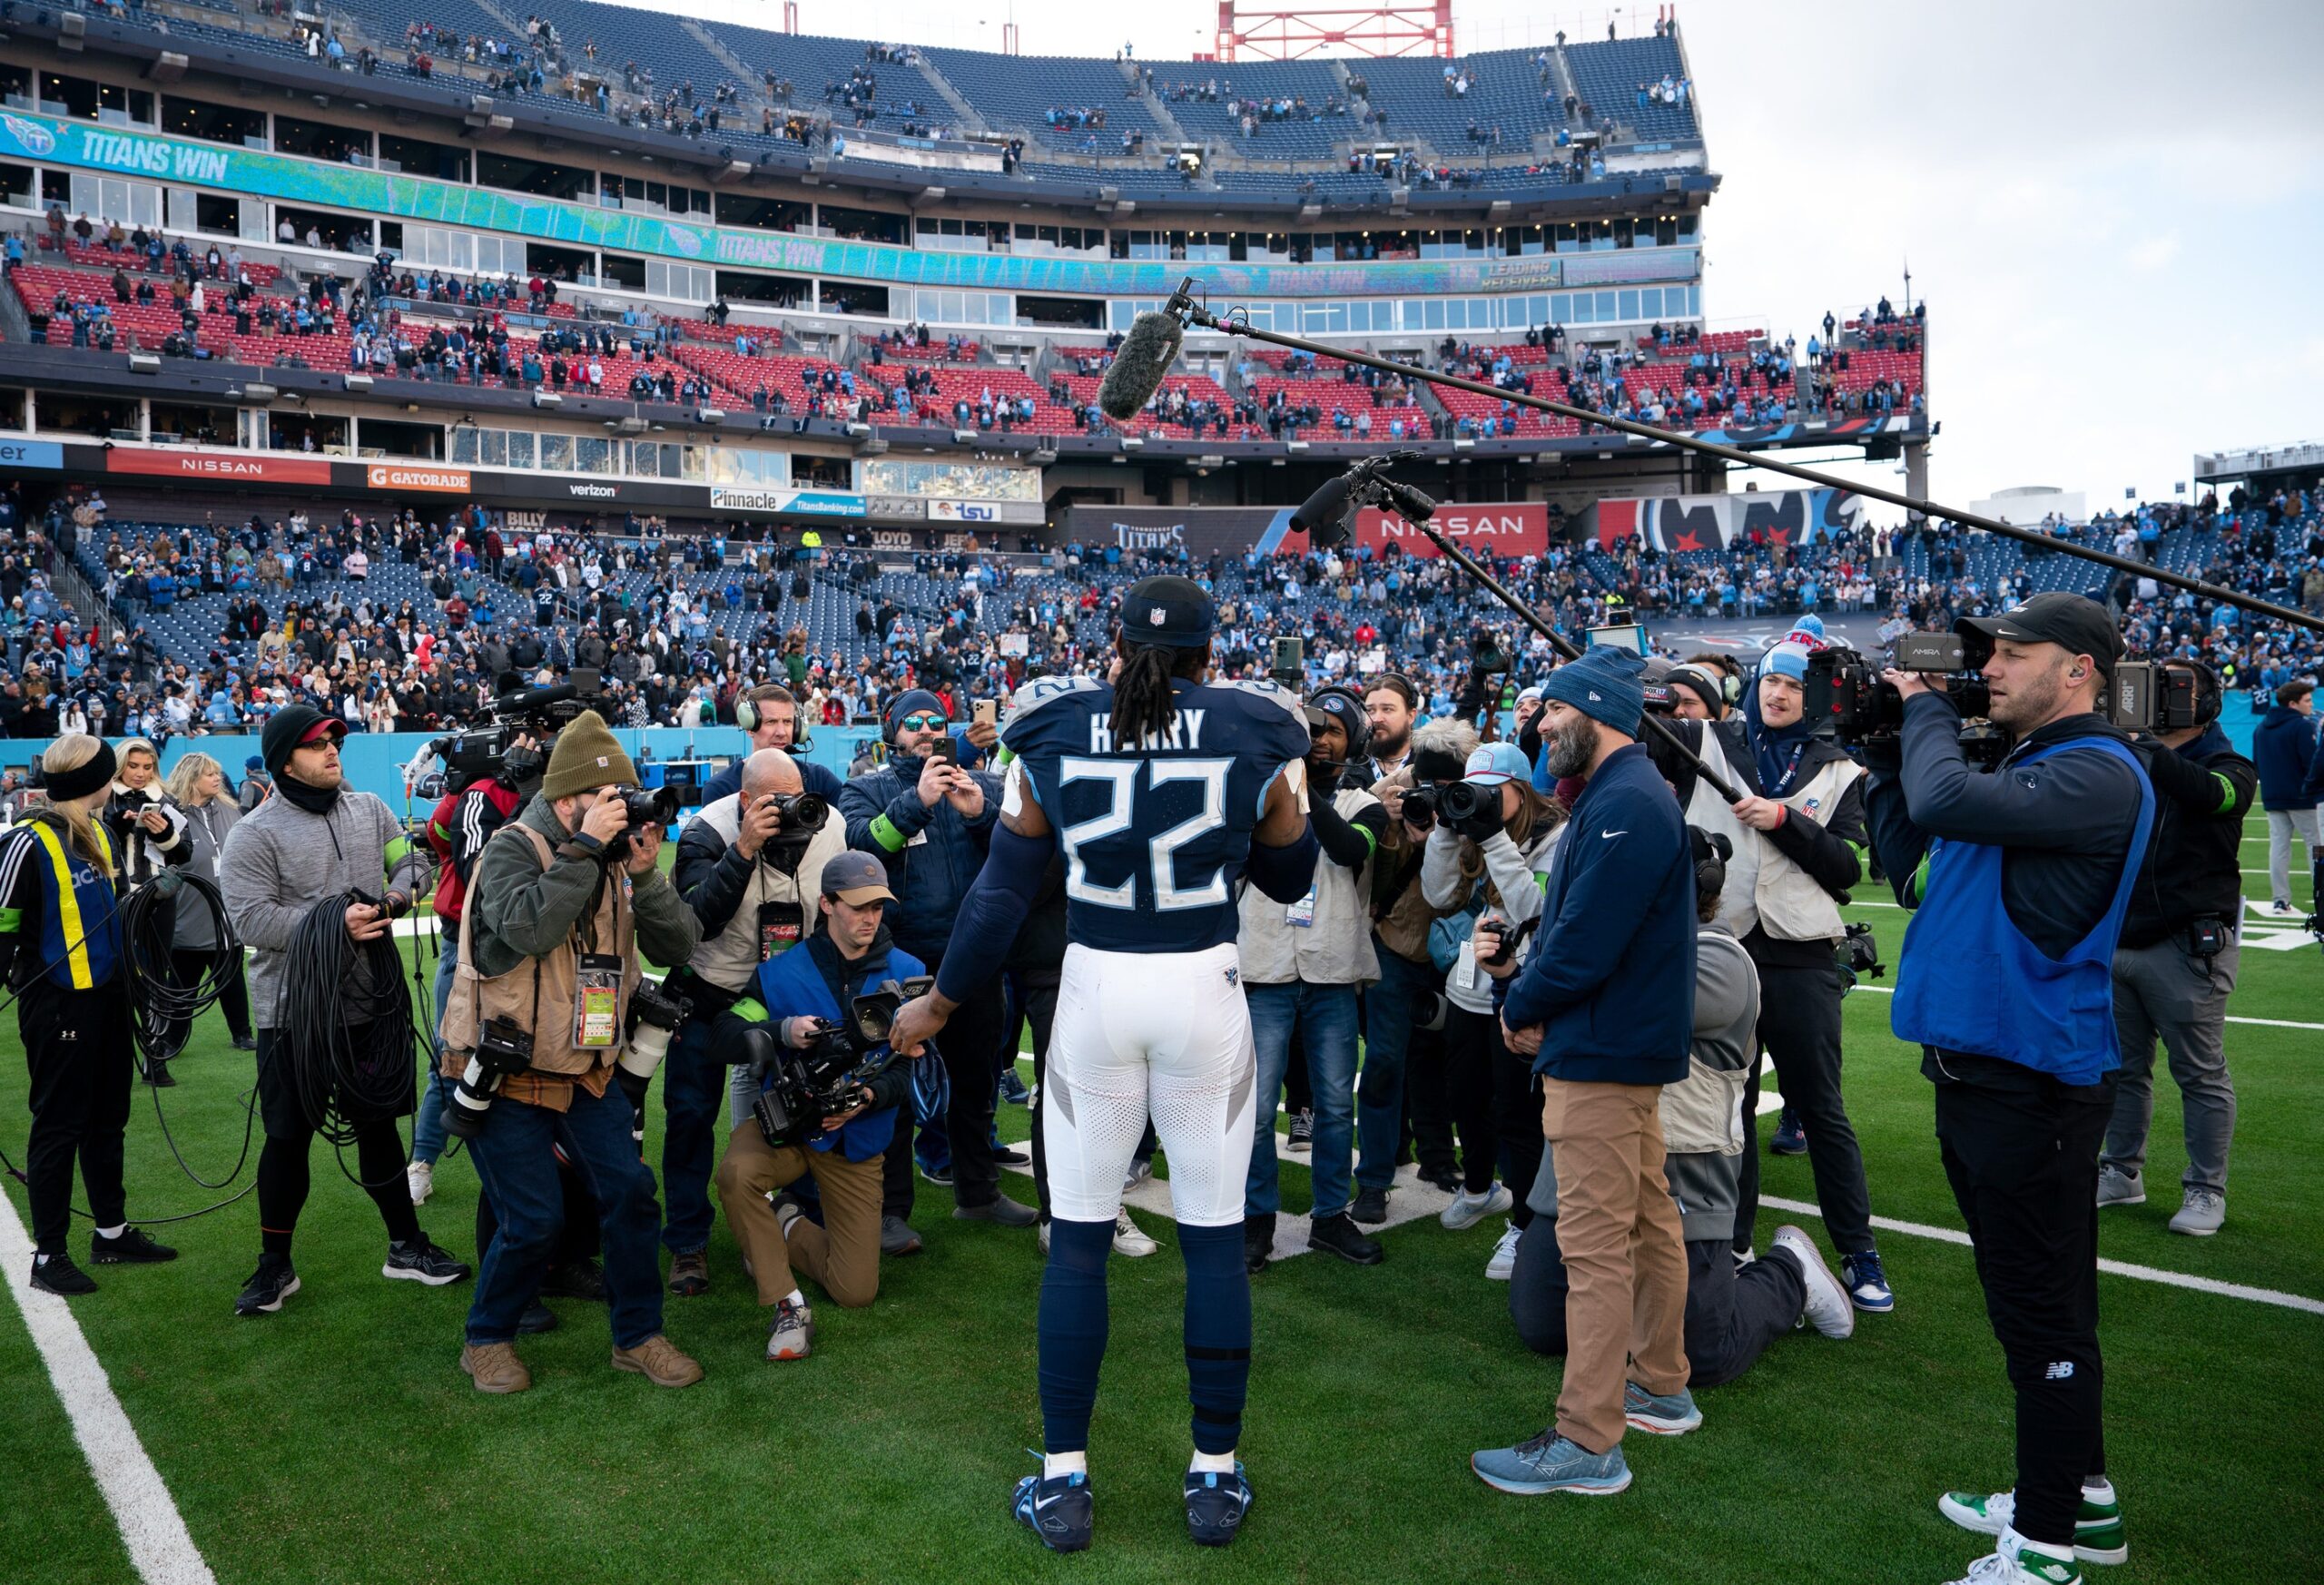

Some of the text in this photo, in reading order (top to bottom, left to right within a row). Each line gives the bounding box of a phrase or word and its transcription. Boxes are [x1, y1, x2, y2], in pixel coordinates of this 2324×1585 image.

[83, 131, 229, 182] TITANS WIN
[719, 233, 825, 269] TITANS WIN
[182, 458, 262, 475] NISSAN
[390, 471, 468, 488] GATORADE
[569, 484, 616, 497] verizon
[713, 488, 776, 510] Pinnacle
[796, 501, 864, 515] TitansBanking.com
[956, 503, 992, 520] tsu
[507, 511, 547, 527] BILLY
[1380, 516, 1523, 537] NISSAN
[1112, 522, 1185, 548] TITANS
[303, 562, 311, 572] 8
[586, 571, 598, 580] 22
[538, 594, 553, 605] 22
[967, 654, 980, 665] 22
[1644, 686, 1658, 694] FOX
[2122, 685, 2134, 714] ARRI
[1089, 708, 1206, 754] HNRY
[1059, 755, 1236, 912] 22
[2044, 1362, 2074, 1379] NB
